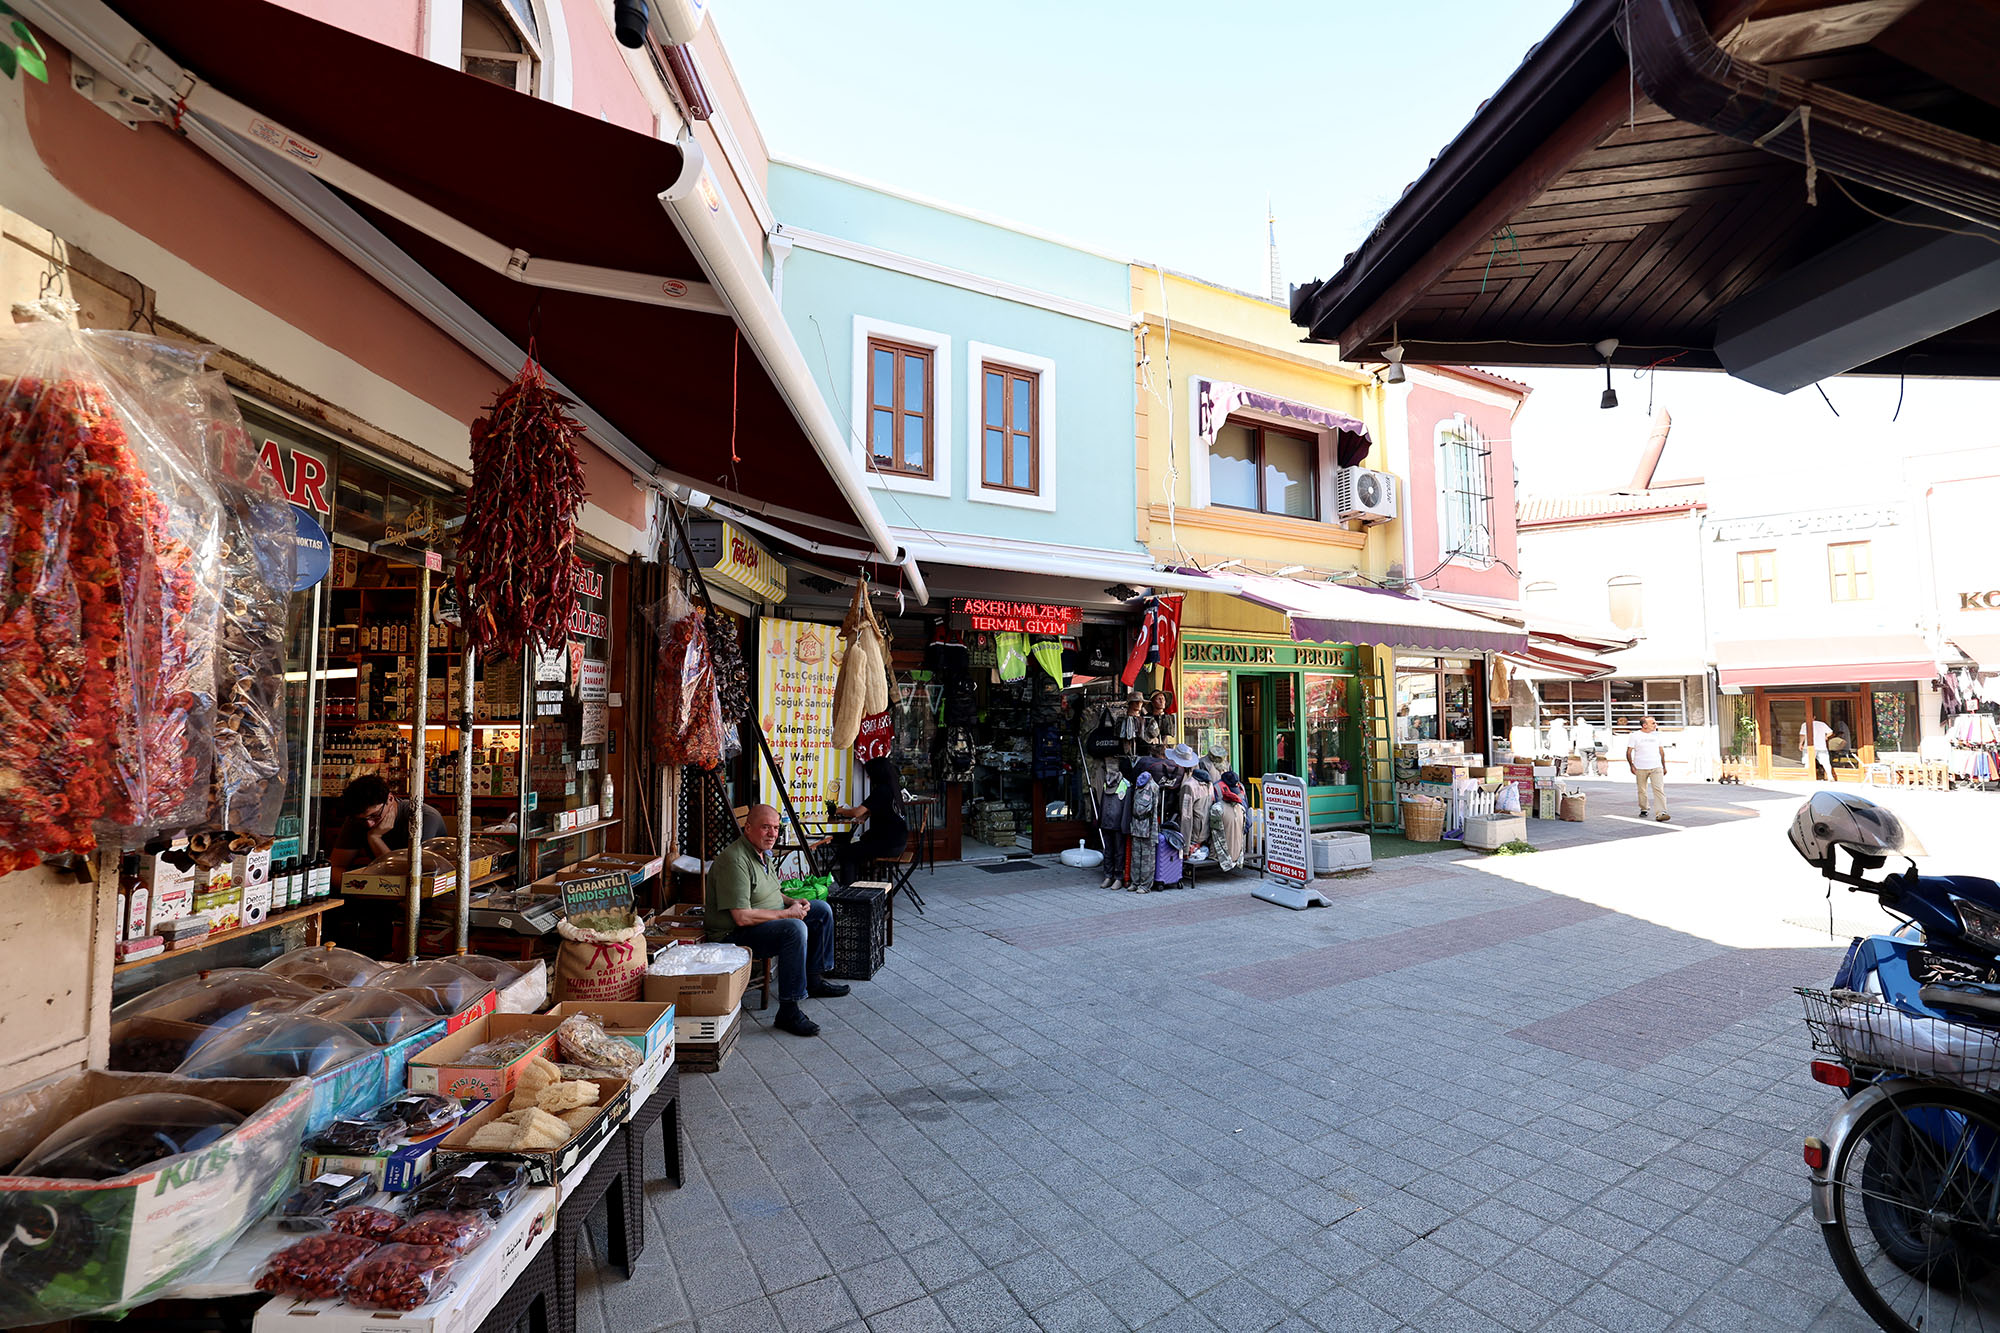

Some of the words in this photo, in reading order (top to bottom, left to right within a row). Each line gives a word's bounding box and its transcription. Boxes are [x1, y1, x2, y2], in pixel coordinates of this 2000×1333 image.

[731, 537, 747, 565] Tost
[964, 600, 1011, 615] ASKERİ
[1014, 603, 1072, 619] MALZEME
[972, 616, 1023, 631] TERMAL
[1026, 619, 1066, 634] GİYİM
[1295, 648, 1345, 666] PERDE
[780, 669, 799, 679] Tost
[801, 671, 835, 683] Çeşitleri
[774, 682, 810, 693] Kahvaltı
[812, 685, 835, 697] Tabağ
[775, 696, 803, 708] Soğuk
[805, 698, 834, 708] Sandvi
[794, 711, 819, 721] Patso
[776, 724, 804, 734] Kalem
[806, 725, 833, 737] Böreği
[765, 738, 798, 748] Patates
[790, 753, 819, 762] Waffle
[796, 766, 813, 777] Çay
[790, 780, 817, 789] Kahve
[787, 794, 823, 803] imonata
[1265, 785, 1301, 799] ÖZBALKAN
[248, 855, 267, 865] Detox
[567, 873, 626, 894] GARANTİLİ
[246, 894, 266, 905] Detox
[596, 899, 609, 910] VE
[616, 895, 630, 905] EL
[567, 978, 595, 988] KURIA
[598, 976, 619, 986] MAL
[621, 972, 627, 981] &
